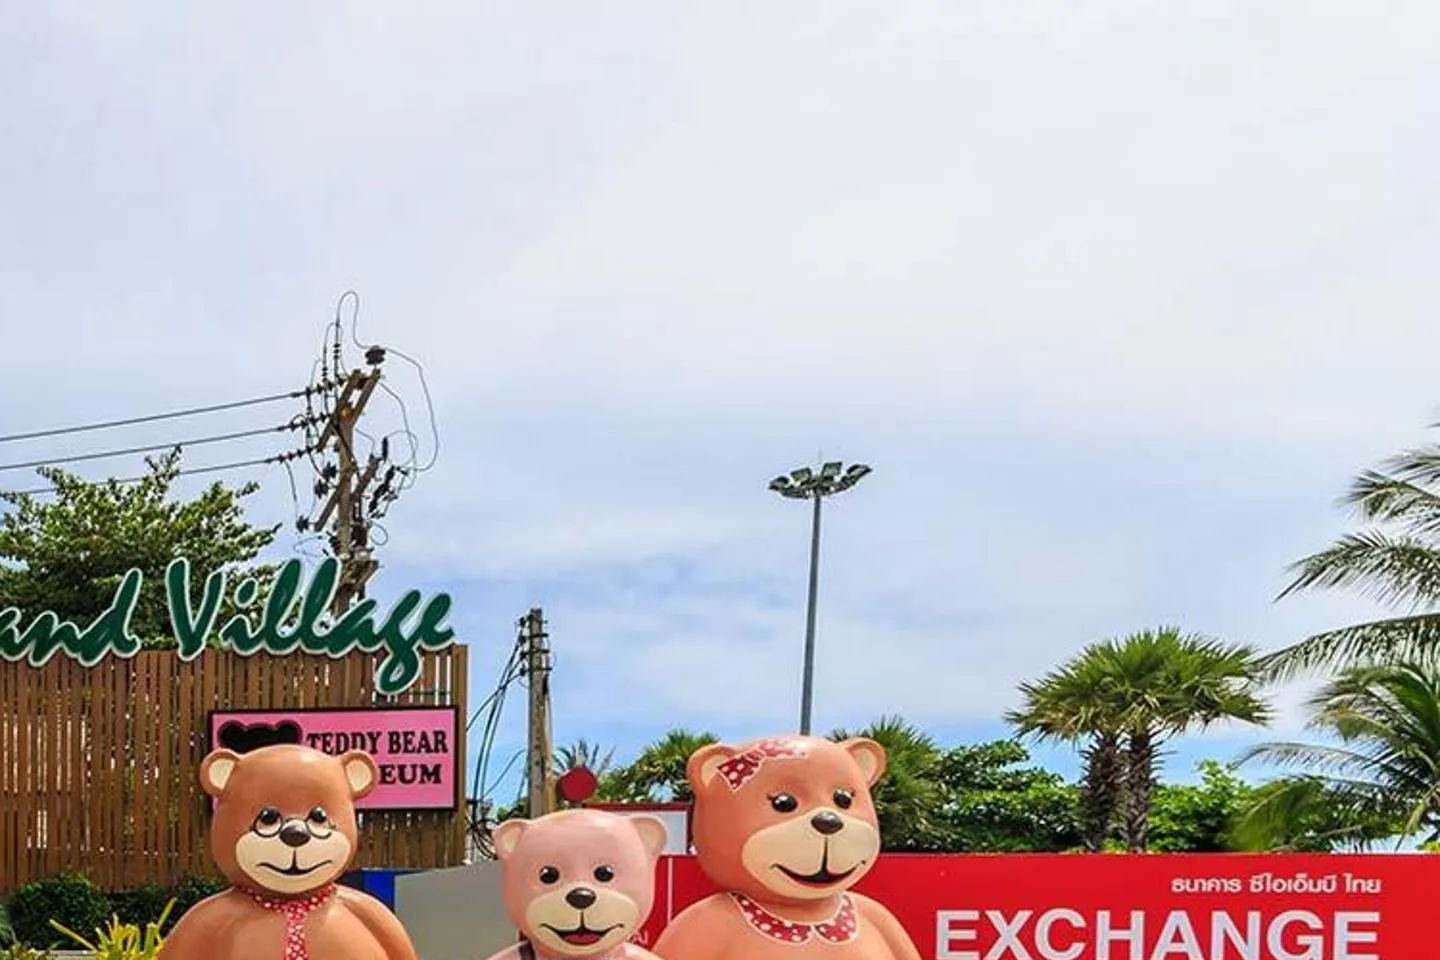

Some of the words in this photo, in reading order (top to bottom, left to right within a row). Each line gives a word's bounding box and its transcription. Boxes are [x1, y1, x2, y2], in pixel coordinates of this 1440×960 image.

[165, 557, 456, 695] Village
[306, 732, 383, 756] TEDDY
[387, 730, 449, 754] BEAR
[378, 764, 443, 785] EUM
[1171, 877, 1242, 893] ธนาคาร
[1249, 872, 1337, 893] ซีไอเอ็มบี
[1343, 873, 1381, 893] ไทย
